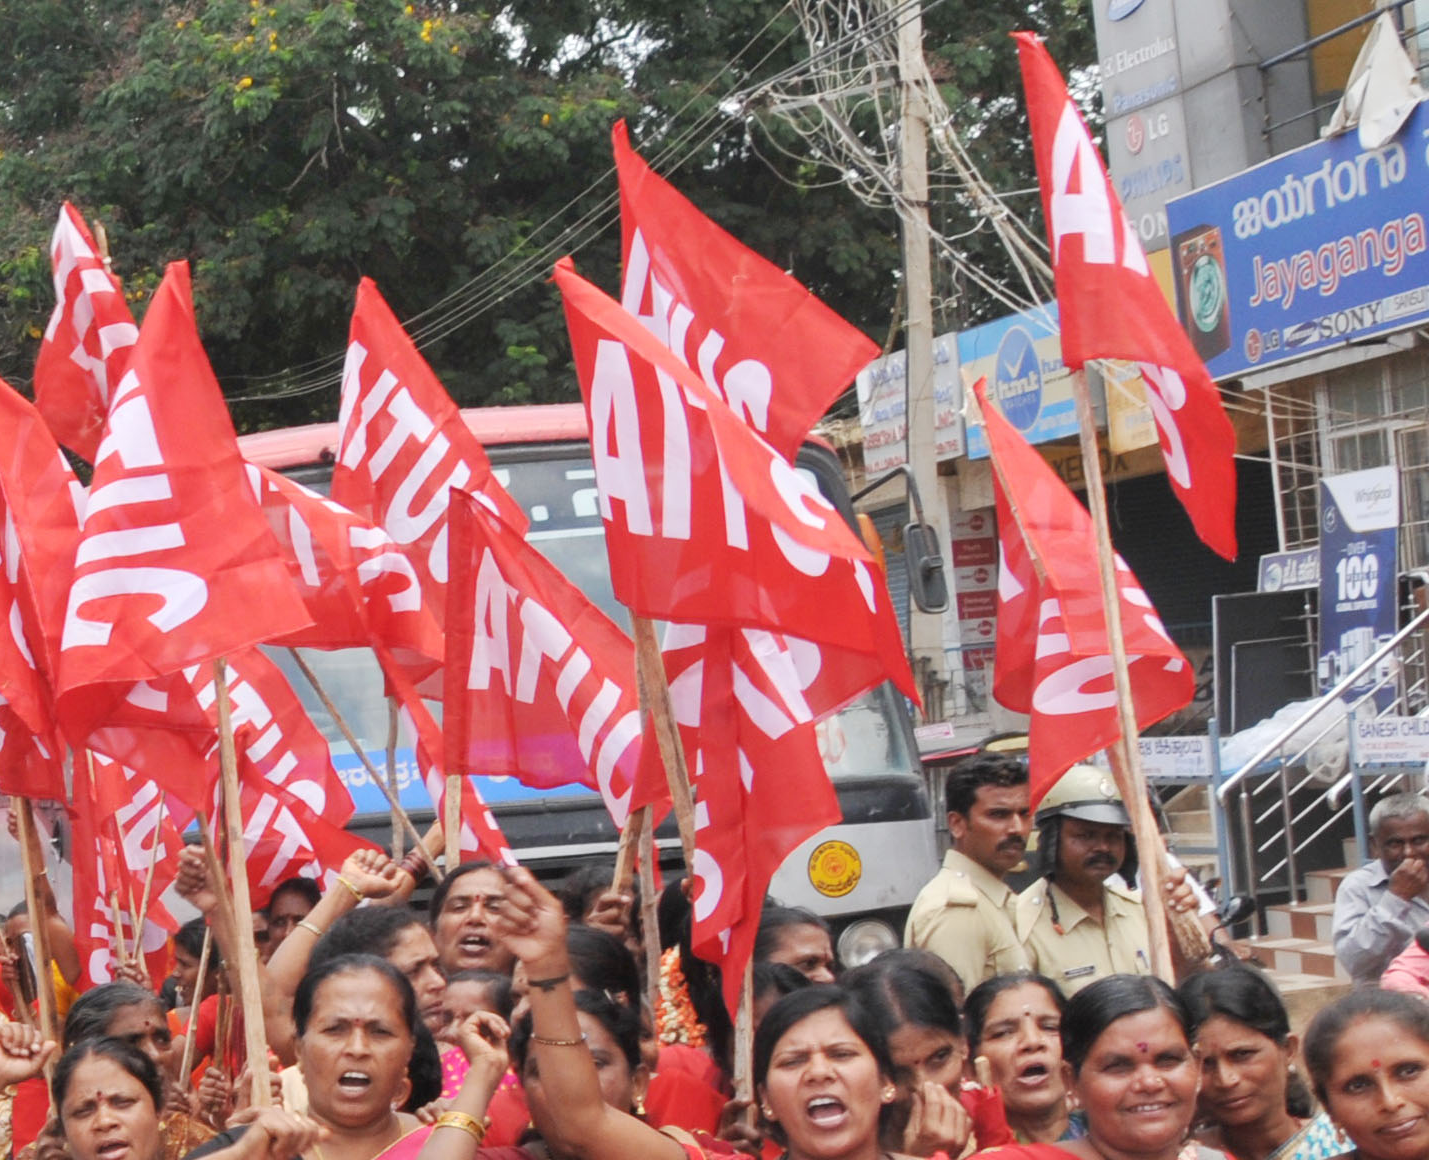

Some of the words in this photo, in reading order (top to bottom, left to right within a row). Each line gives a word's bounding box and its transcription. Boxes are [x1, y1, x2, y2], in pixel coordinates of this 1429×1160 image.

[1115, 36, 1176, 74] Electrolux
[1148, 113, 1170, 141] LG
[1250, 213, 1426, 309] Jayaganga
[1263, 328, 1280, 351] LG
[1319, 301, 1382, 339] SONY
[998, 370, 1040, 400] hmt
[1336, 554, 1378, 601] 100
